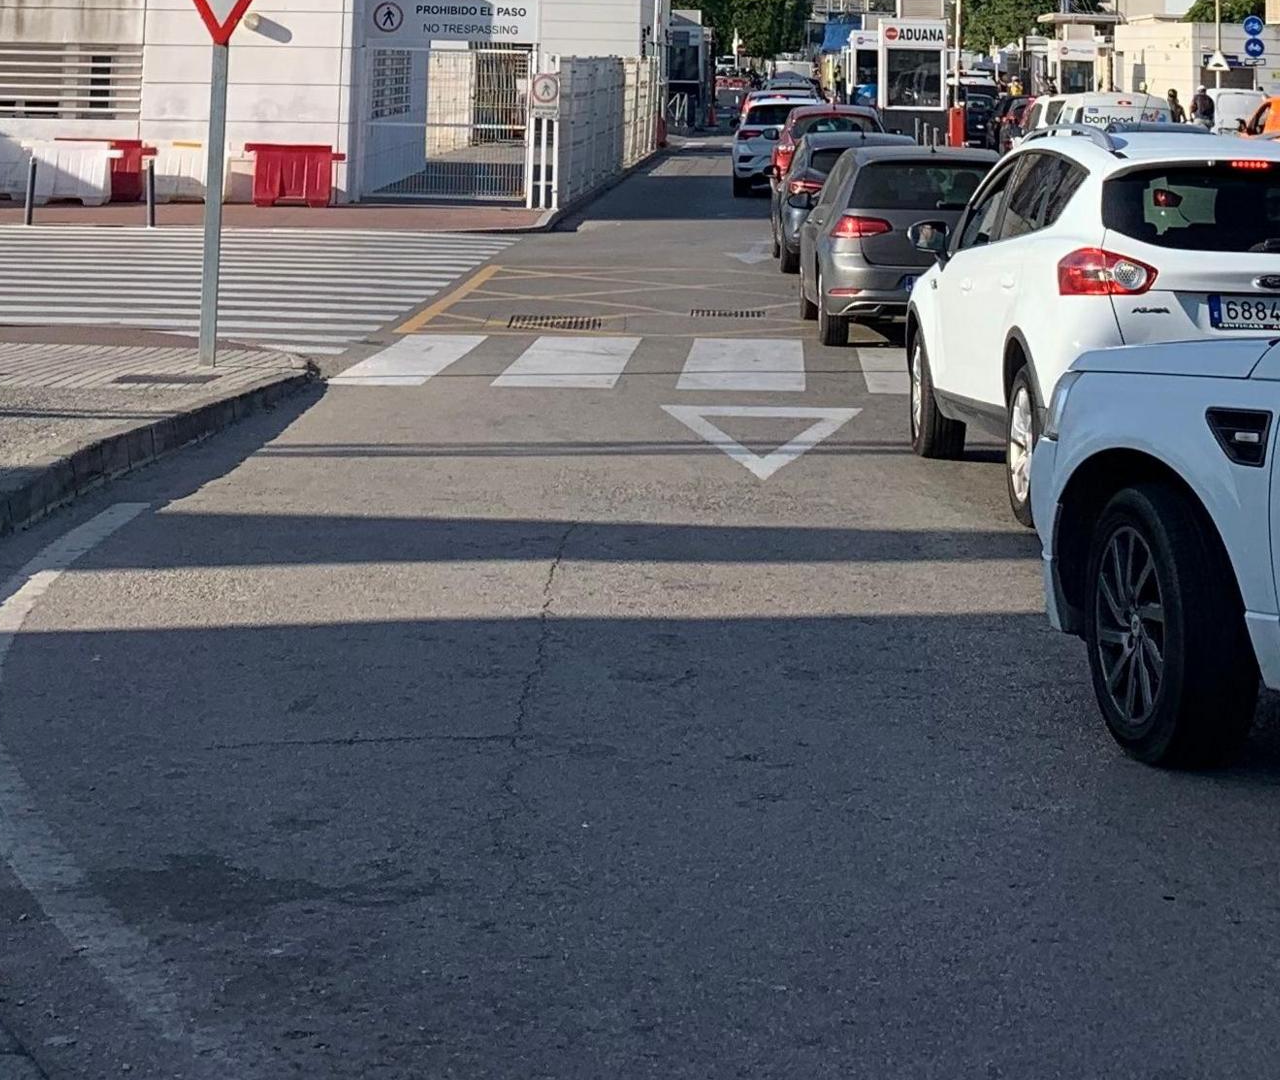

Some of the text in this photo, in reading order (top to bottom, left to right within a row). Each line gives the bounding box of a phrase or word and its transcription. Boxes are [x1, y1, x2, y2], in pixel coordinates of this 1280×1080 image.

[415, 4, 527, 17] PROHIBIDO EL PASO
[423, 23, 519, 35] NO TRESPASSING
[898, 27, 945, 42] ADUANA
